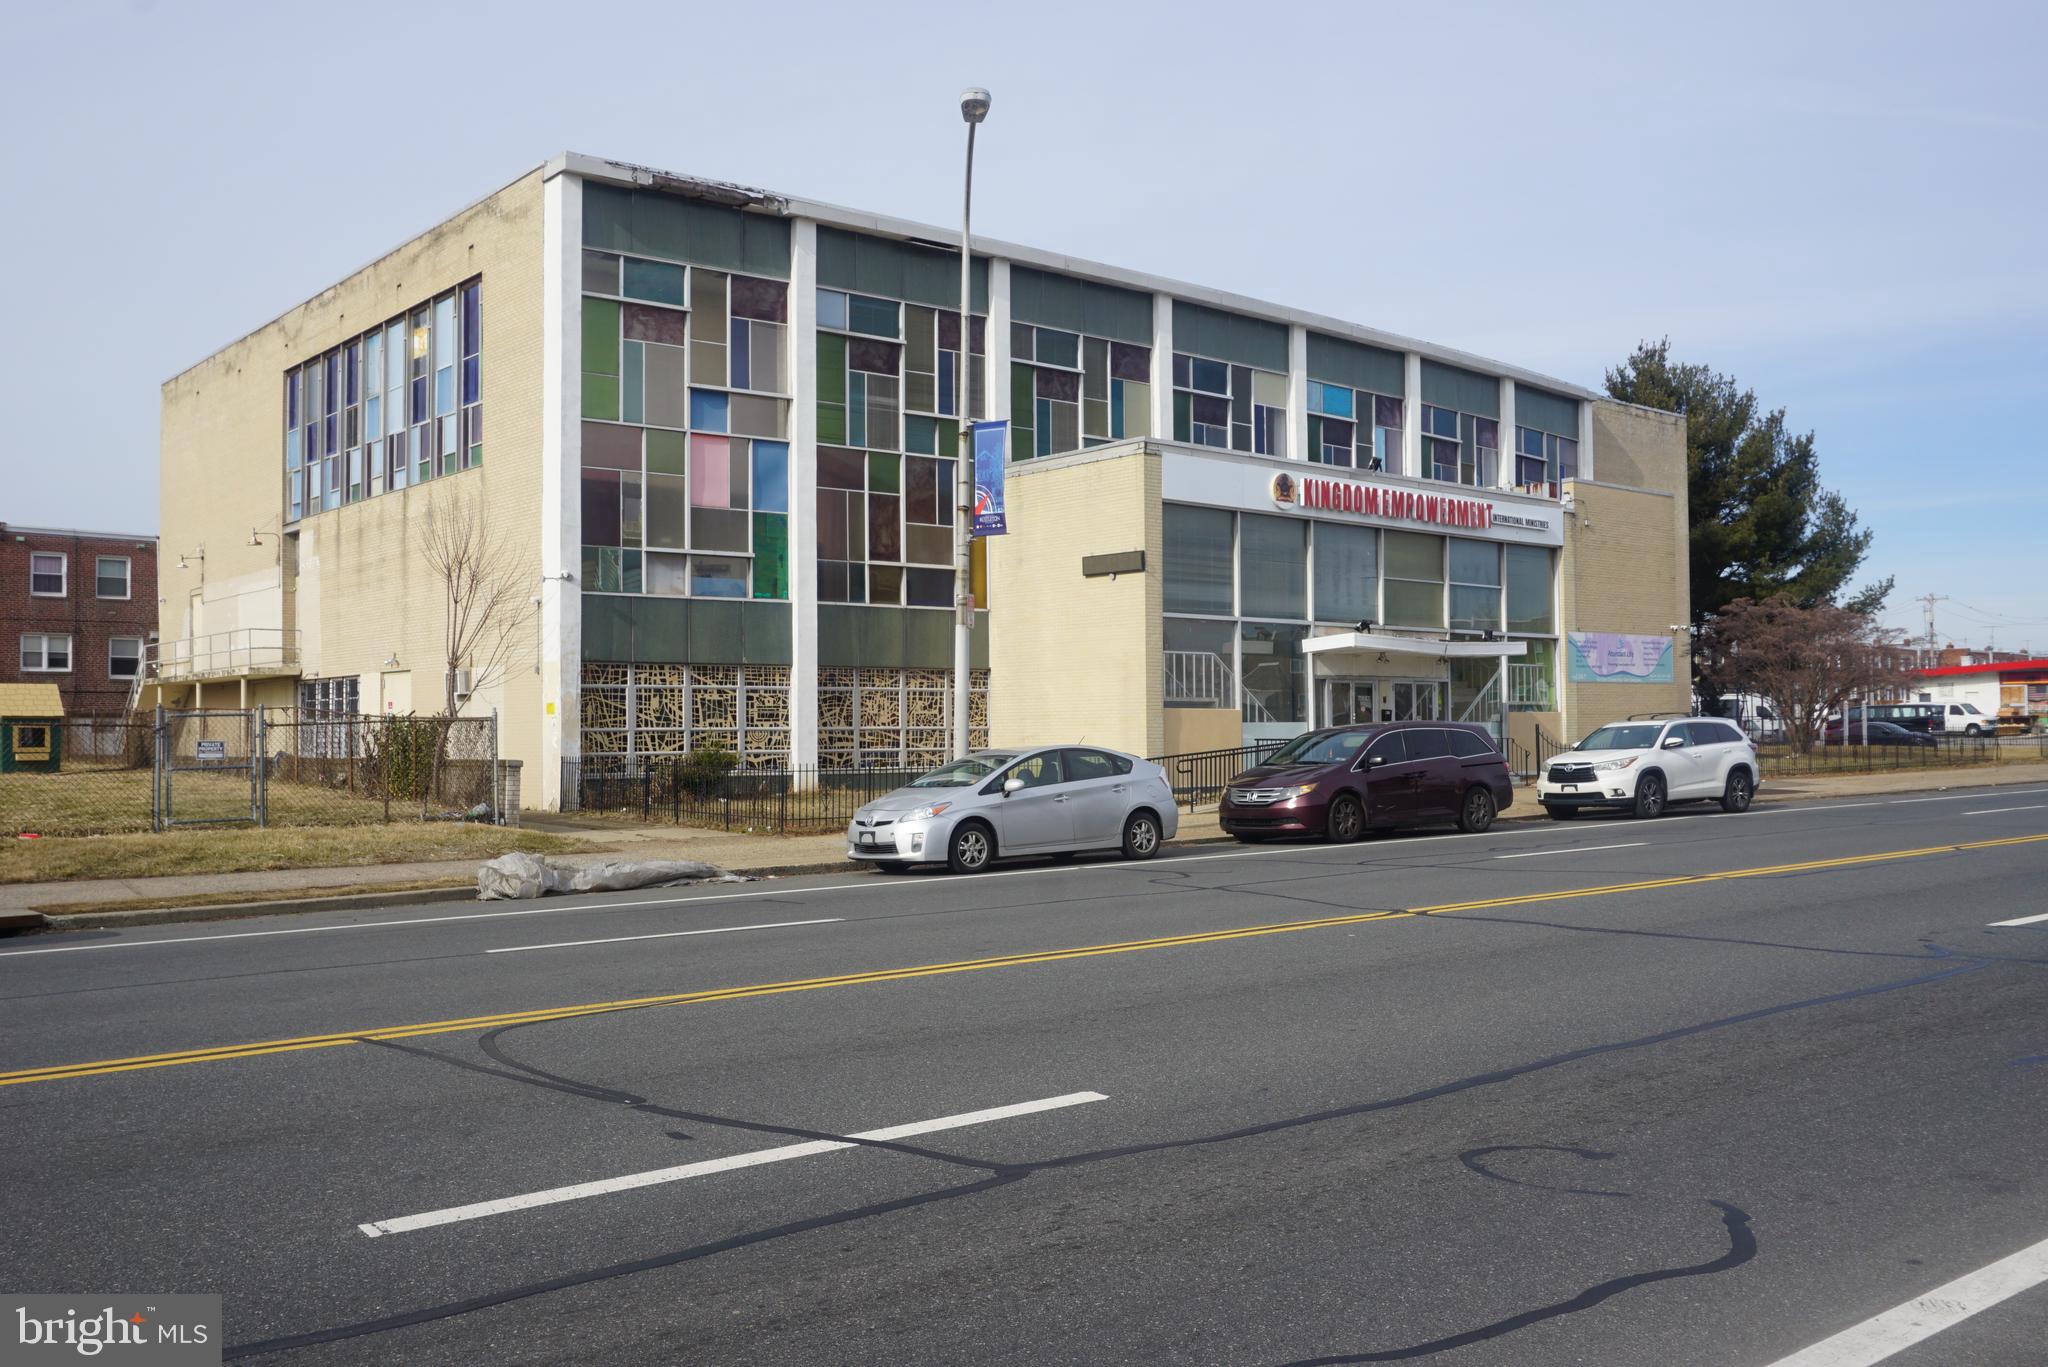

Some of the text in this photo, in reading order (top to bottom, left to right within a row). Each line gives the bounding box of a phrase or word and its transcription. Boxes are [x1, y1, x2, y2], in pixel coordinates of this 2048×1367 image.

[1303, 477, 1493, 529] KINGDOM EMPOWERMENT
[1492, 513, 1550, 529] INTERNATIONAL MINISTRIES
